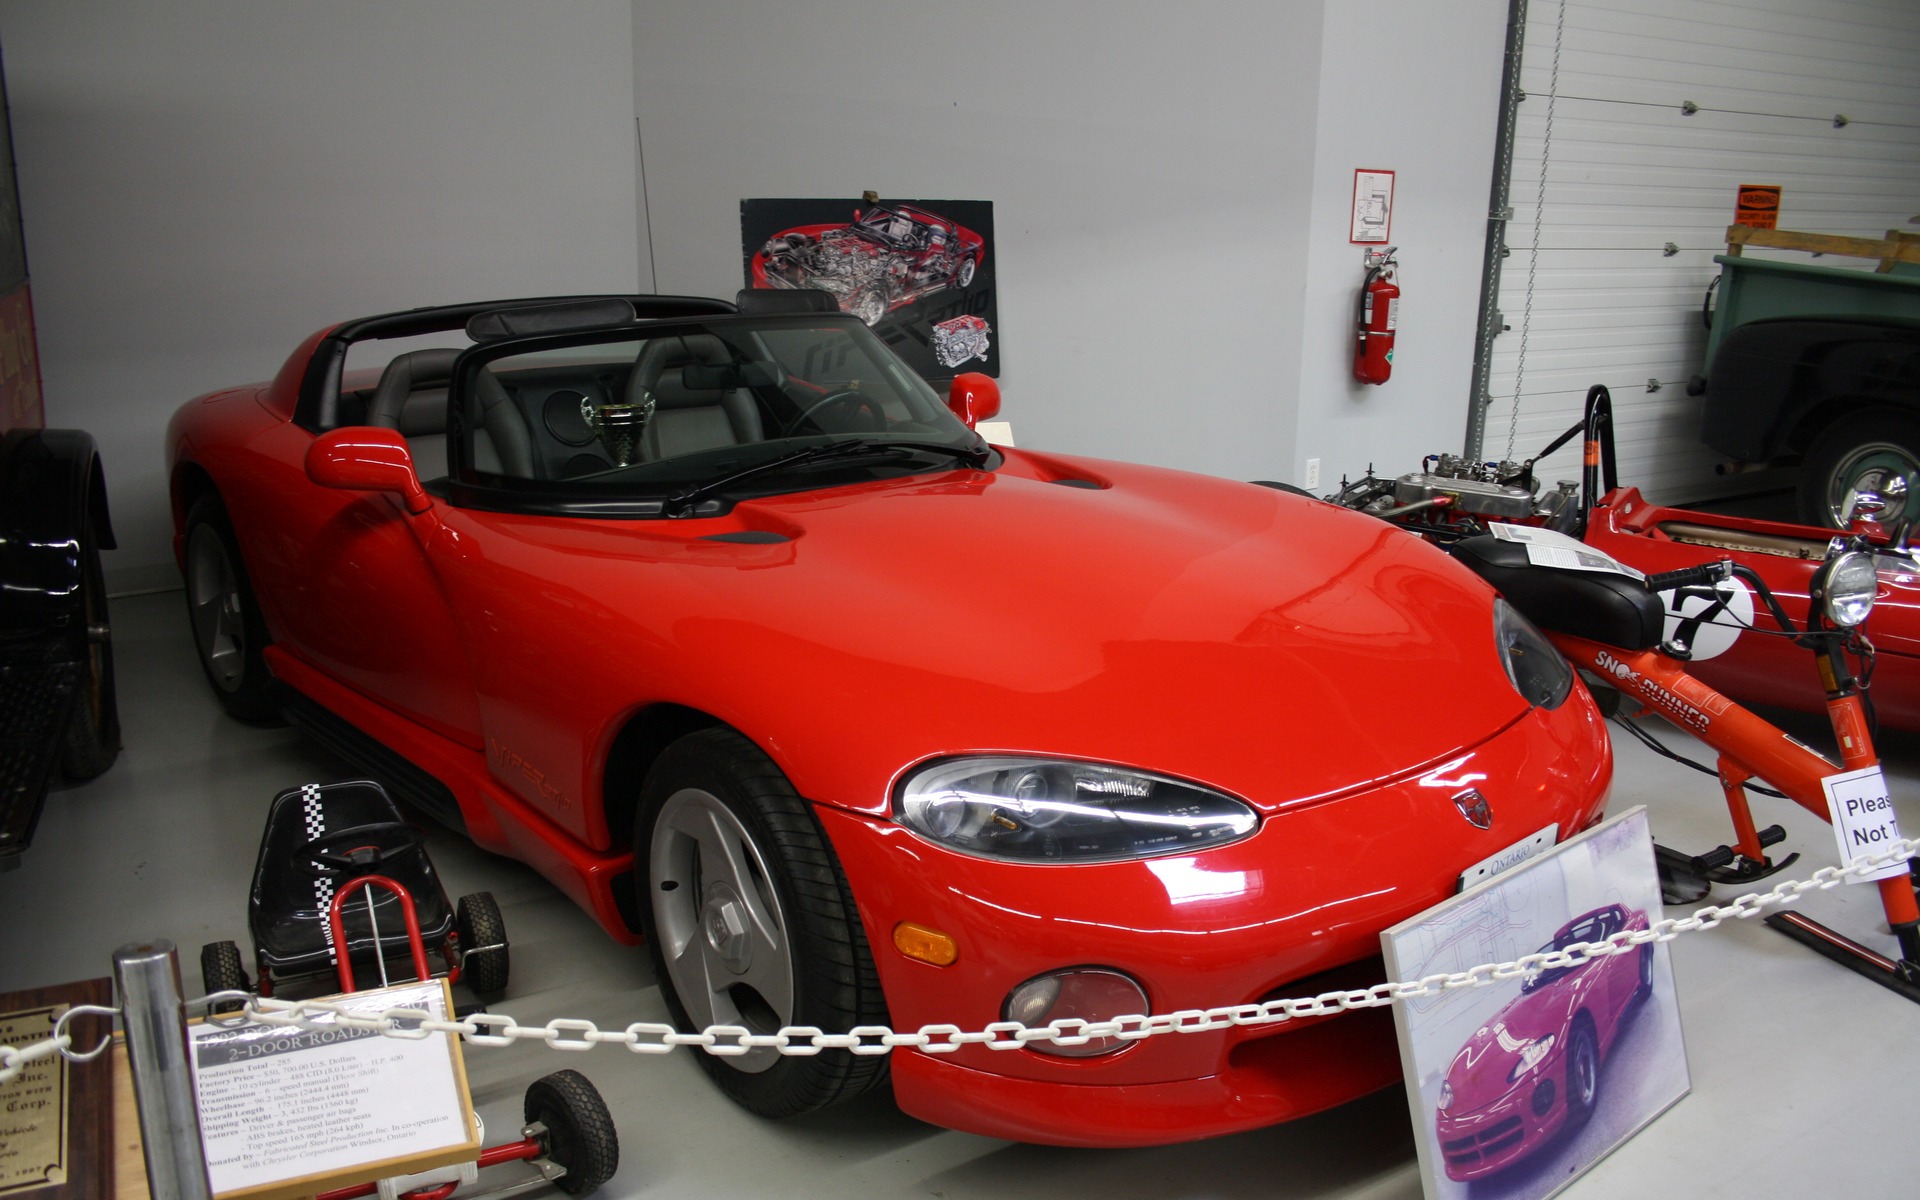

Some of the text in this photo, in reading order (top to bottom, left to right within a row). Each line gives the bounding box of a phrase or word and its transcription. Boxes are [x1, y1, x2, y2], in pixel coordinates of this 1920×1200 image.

[1639, 678, 1711, 733] RUNNER
[1853, 824, 1888, 846] Not
[1490, 844, 1530, 876] ONTARIO
[307, 1019, 402, 1046] ROADSR
[199, 1068, 244, 1080] Production
[247, 1062, 269, 1072] Total
[199, 1077, 231, 1089] Factory
[233, 1074, 255, 1083] Price
[329, 1055, 356, 1064] Dollars
[200, 1087, 229, 1098] Engine
[249, 1077, 281, 1088] cylinder
[201, 1091, 256, 1105] Transmission
[279, 1082, 301, 1093] speed
[303, 1077, 331, 1087] manual
[201, 1101, 246, 1114] Wheelbase
[273, 1091, 299, 1101] inches
[235, 1107, 265, 1118] Length
[300, 1095, 325, 1104] inches
[241, 1113, 272, 1125] Weight
[286, 1113, 324, 1126] passenger
[325, 1117, 354, 1126] leather
[386, 1129, 416, 1141] Ontario
